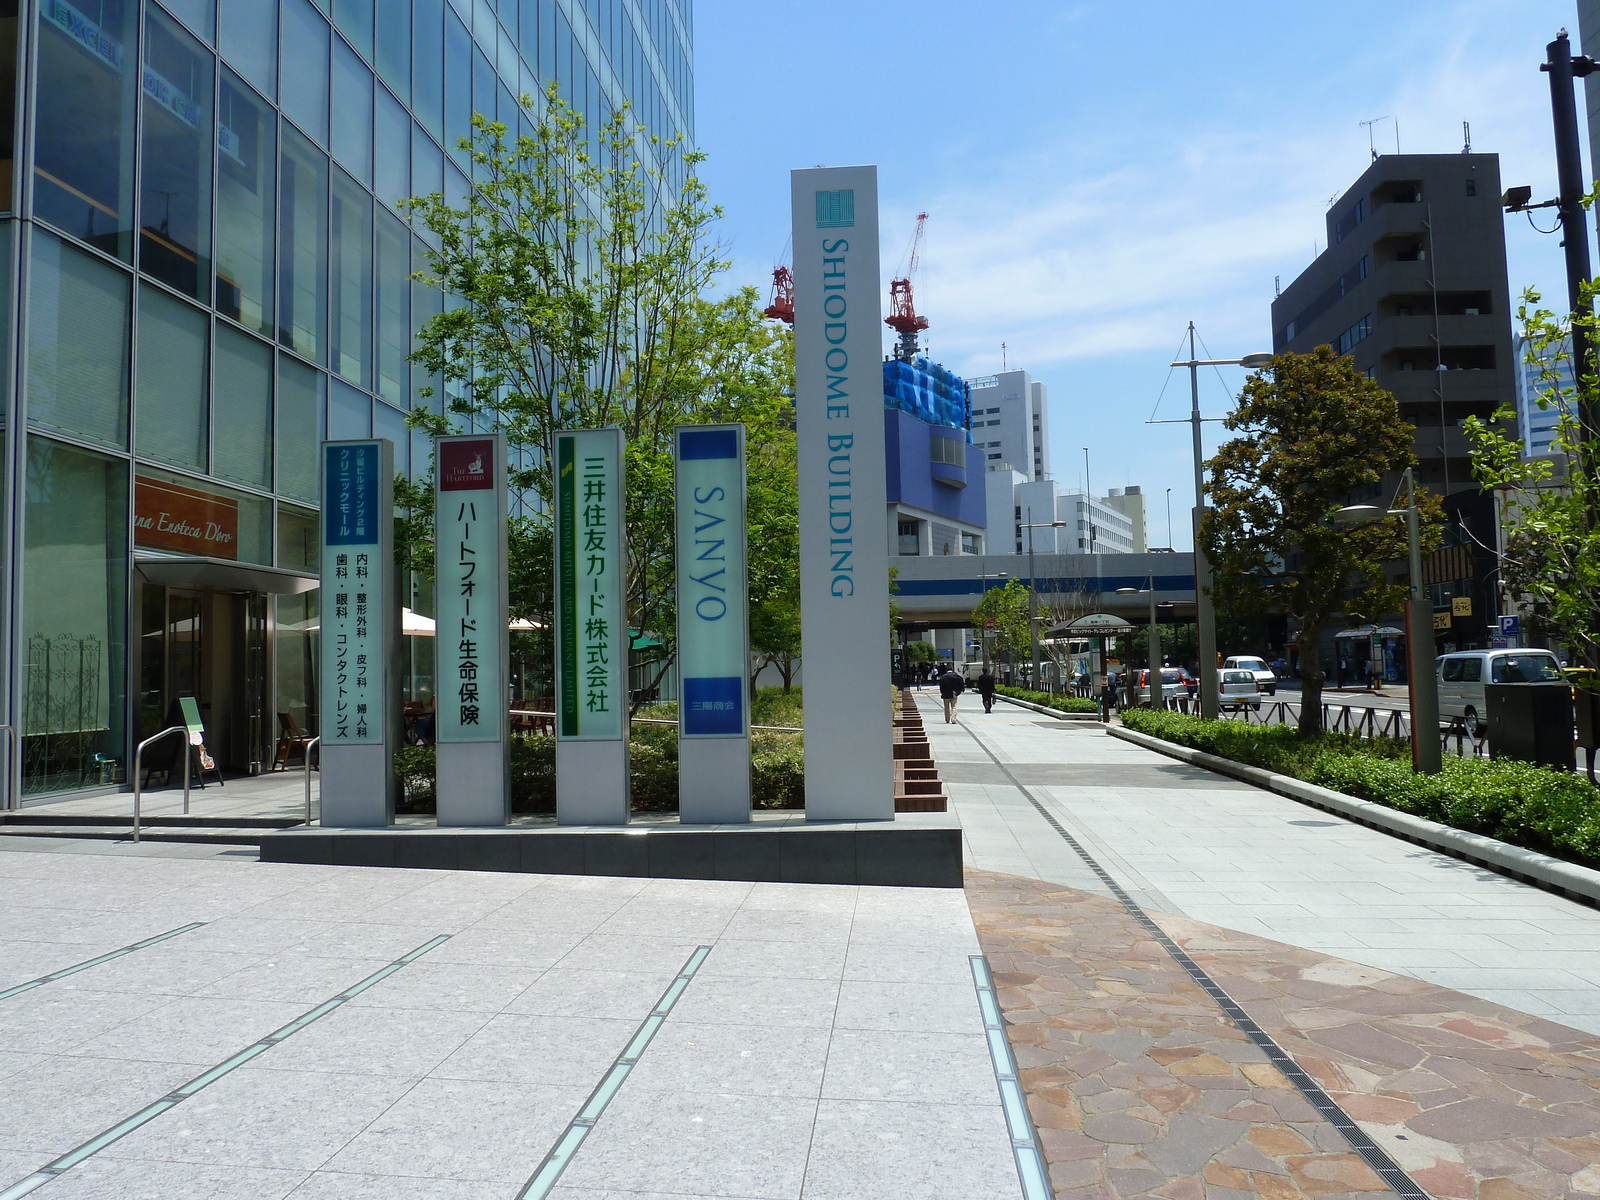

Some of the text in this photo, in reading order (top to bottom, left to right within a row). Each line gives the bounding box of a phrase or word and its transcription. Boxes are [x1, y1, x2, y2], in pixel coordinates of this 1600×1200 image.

[822, 238, 854, 600] SHIODOME BUILDING
[157, 512, 202, 539] Enoteca
[339, 449, 350, 537] クリニックモール
[563, 492, 575, 713] SUMITOMO MITSUI CARD COMPANY LIMITED
[583, 457, 609, 713] 三井住友カード株式会社
[689, 486, 727, 622] SANYO
[457, 502, 480, 726] ハートフォード生命保険
[894, 654, 901, 662] P
[1503, 618, 1513, 630] P
[691, 700, 735, 711] 三陽商会
